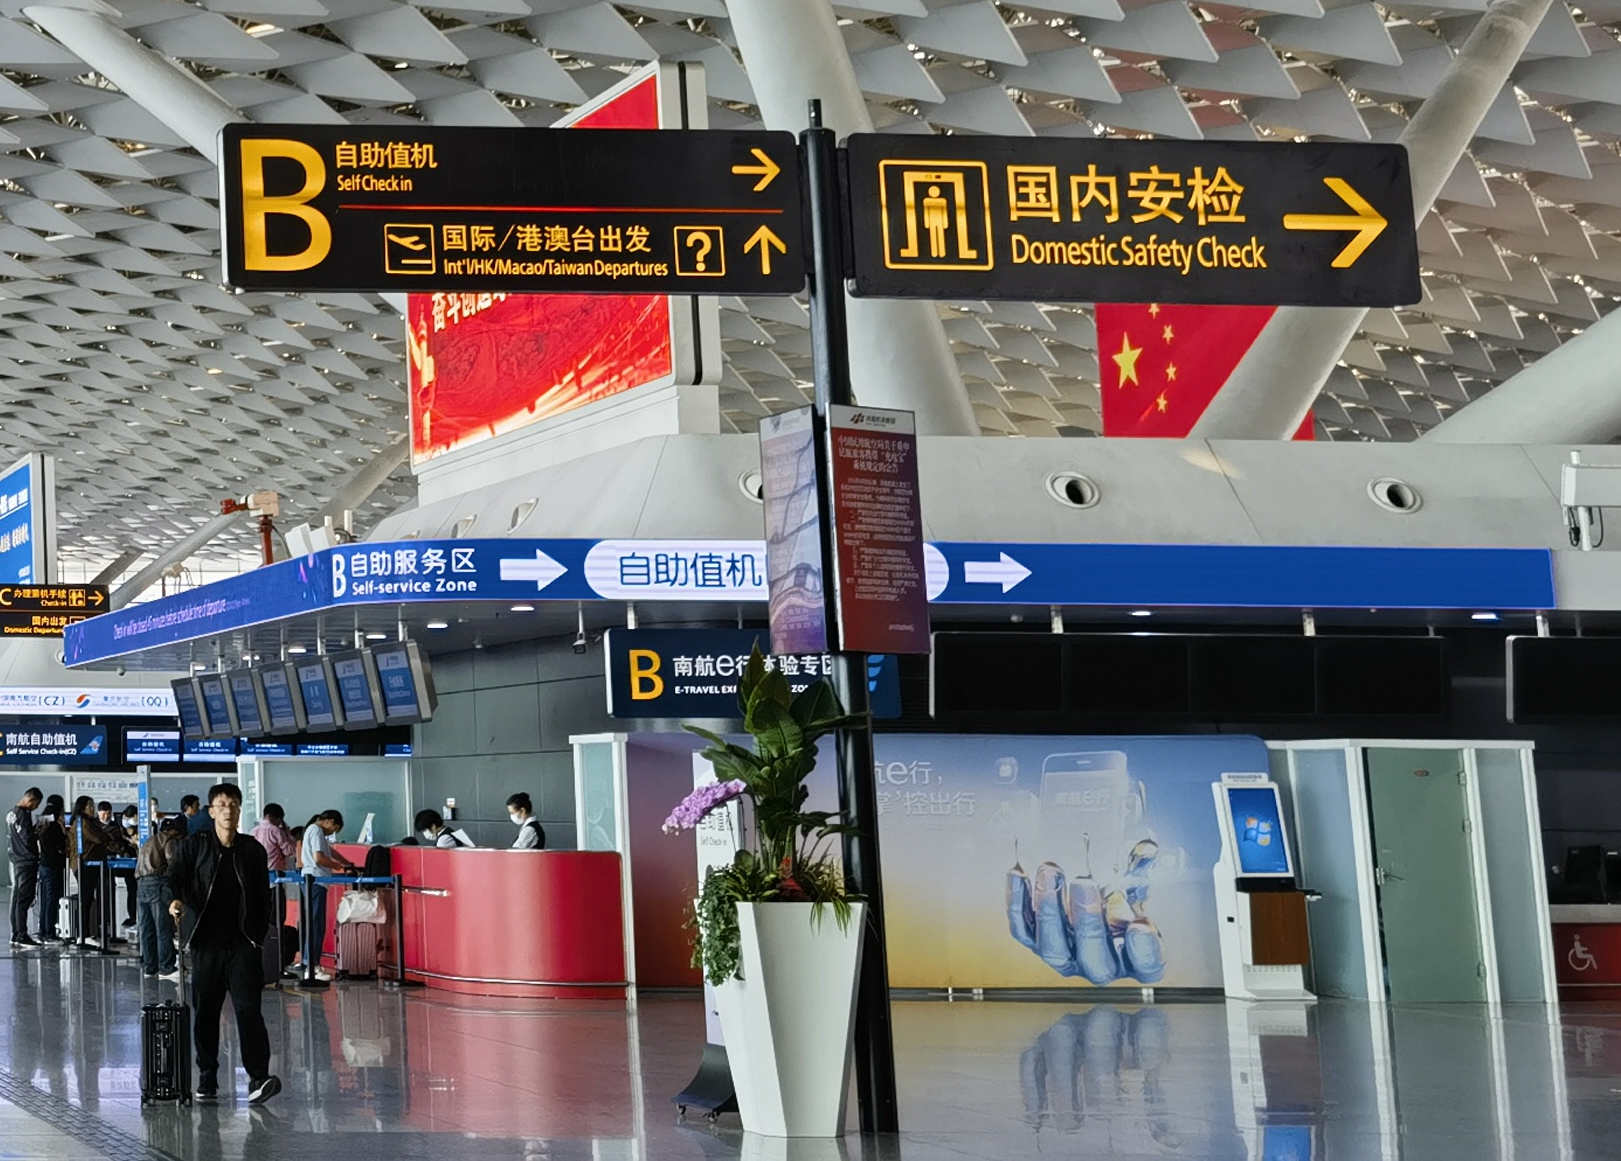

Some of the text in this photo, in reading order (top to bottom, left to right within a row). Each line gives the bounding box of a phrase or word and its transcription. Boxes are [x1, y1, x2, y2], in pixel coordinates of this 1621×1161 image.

[335, 141, 438, 169] 自助值机
[240, 138, 332, 271] B
[1006, 164, 1246, 226] 国内安检
[594, 259, 669, 279] Departures
[1011, 234, 1267, 275] Domestic Safety Check
[332, 553, 346, 598] B
[351, 548, 477, 577] 自助服务区
[619, 552, 762, 587] 自助值机
[352, 578, 478, 596] Self-service Zone
[31, 616, 67, 626] 国内出发
[629, 649, 665, 700] B
[675, 685, 720, 695] E-TRAVEL
[791, 684, 809, 693] ZO
[6, 733, 77, 745] 南航自助值机
